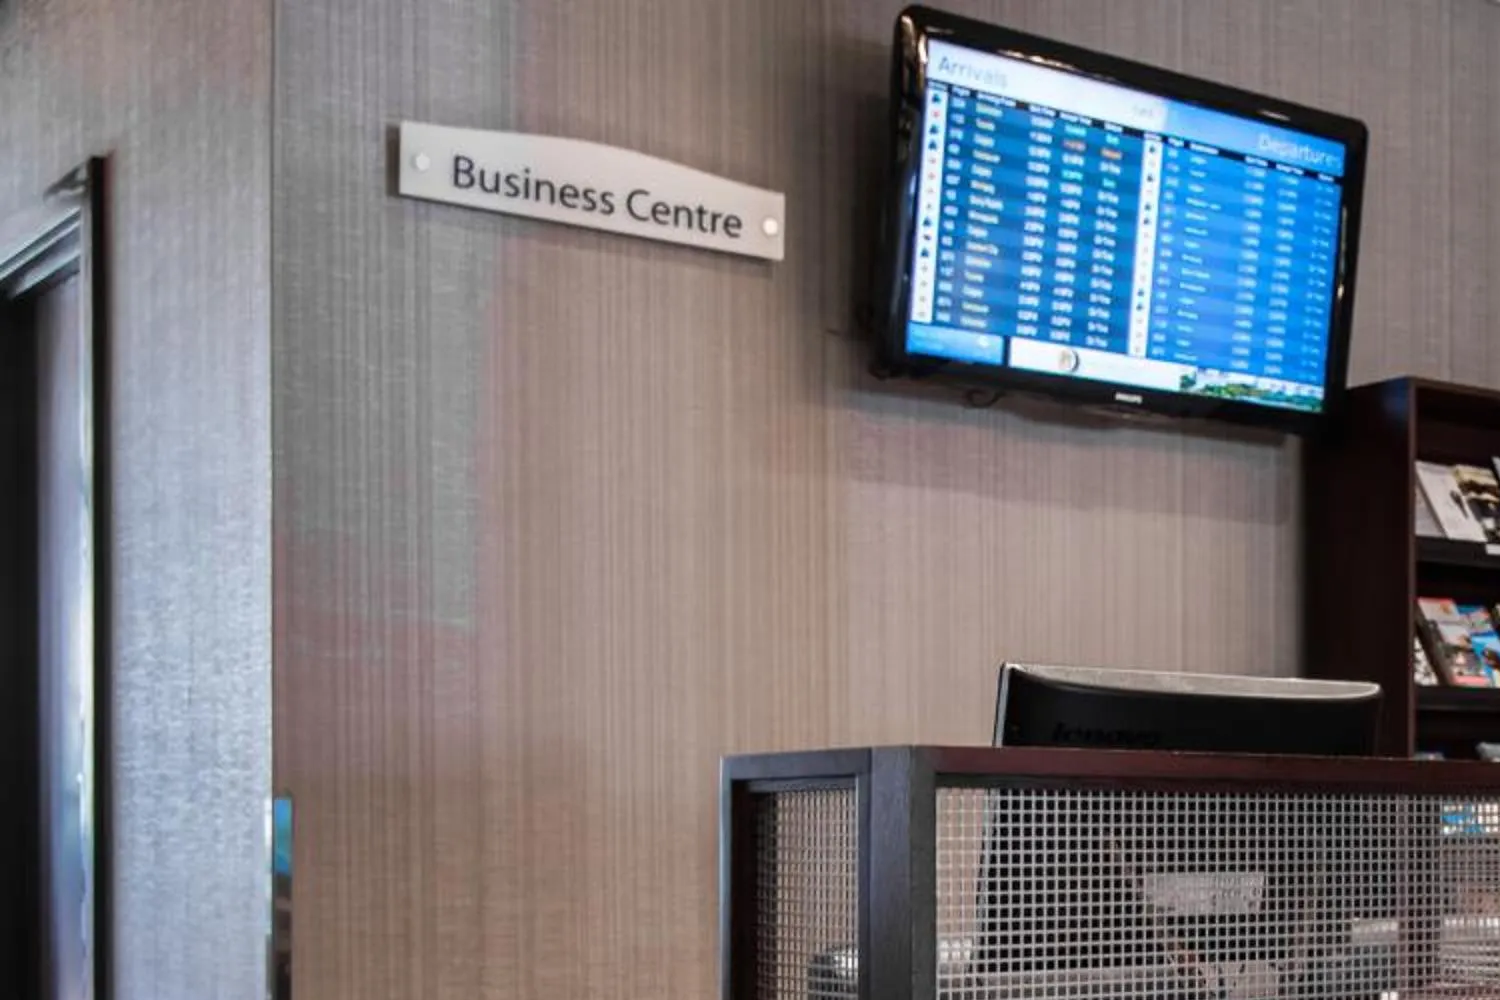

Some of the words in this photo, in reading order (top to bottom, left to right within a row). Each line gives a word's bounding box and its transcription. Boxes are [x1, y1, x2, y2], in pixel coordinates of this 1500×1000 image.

[938, 55, 1008, 88] Arrivals
[452, 154, 616, 216] Business
[625, 188, 744, 239] Centre
